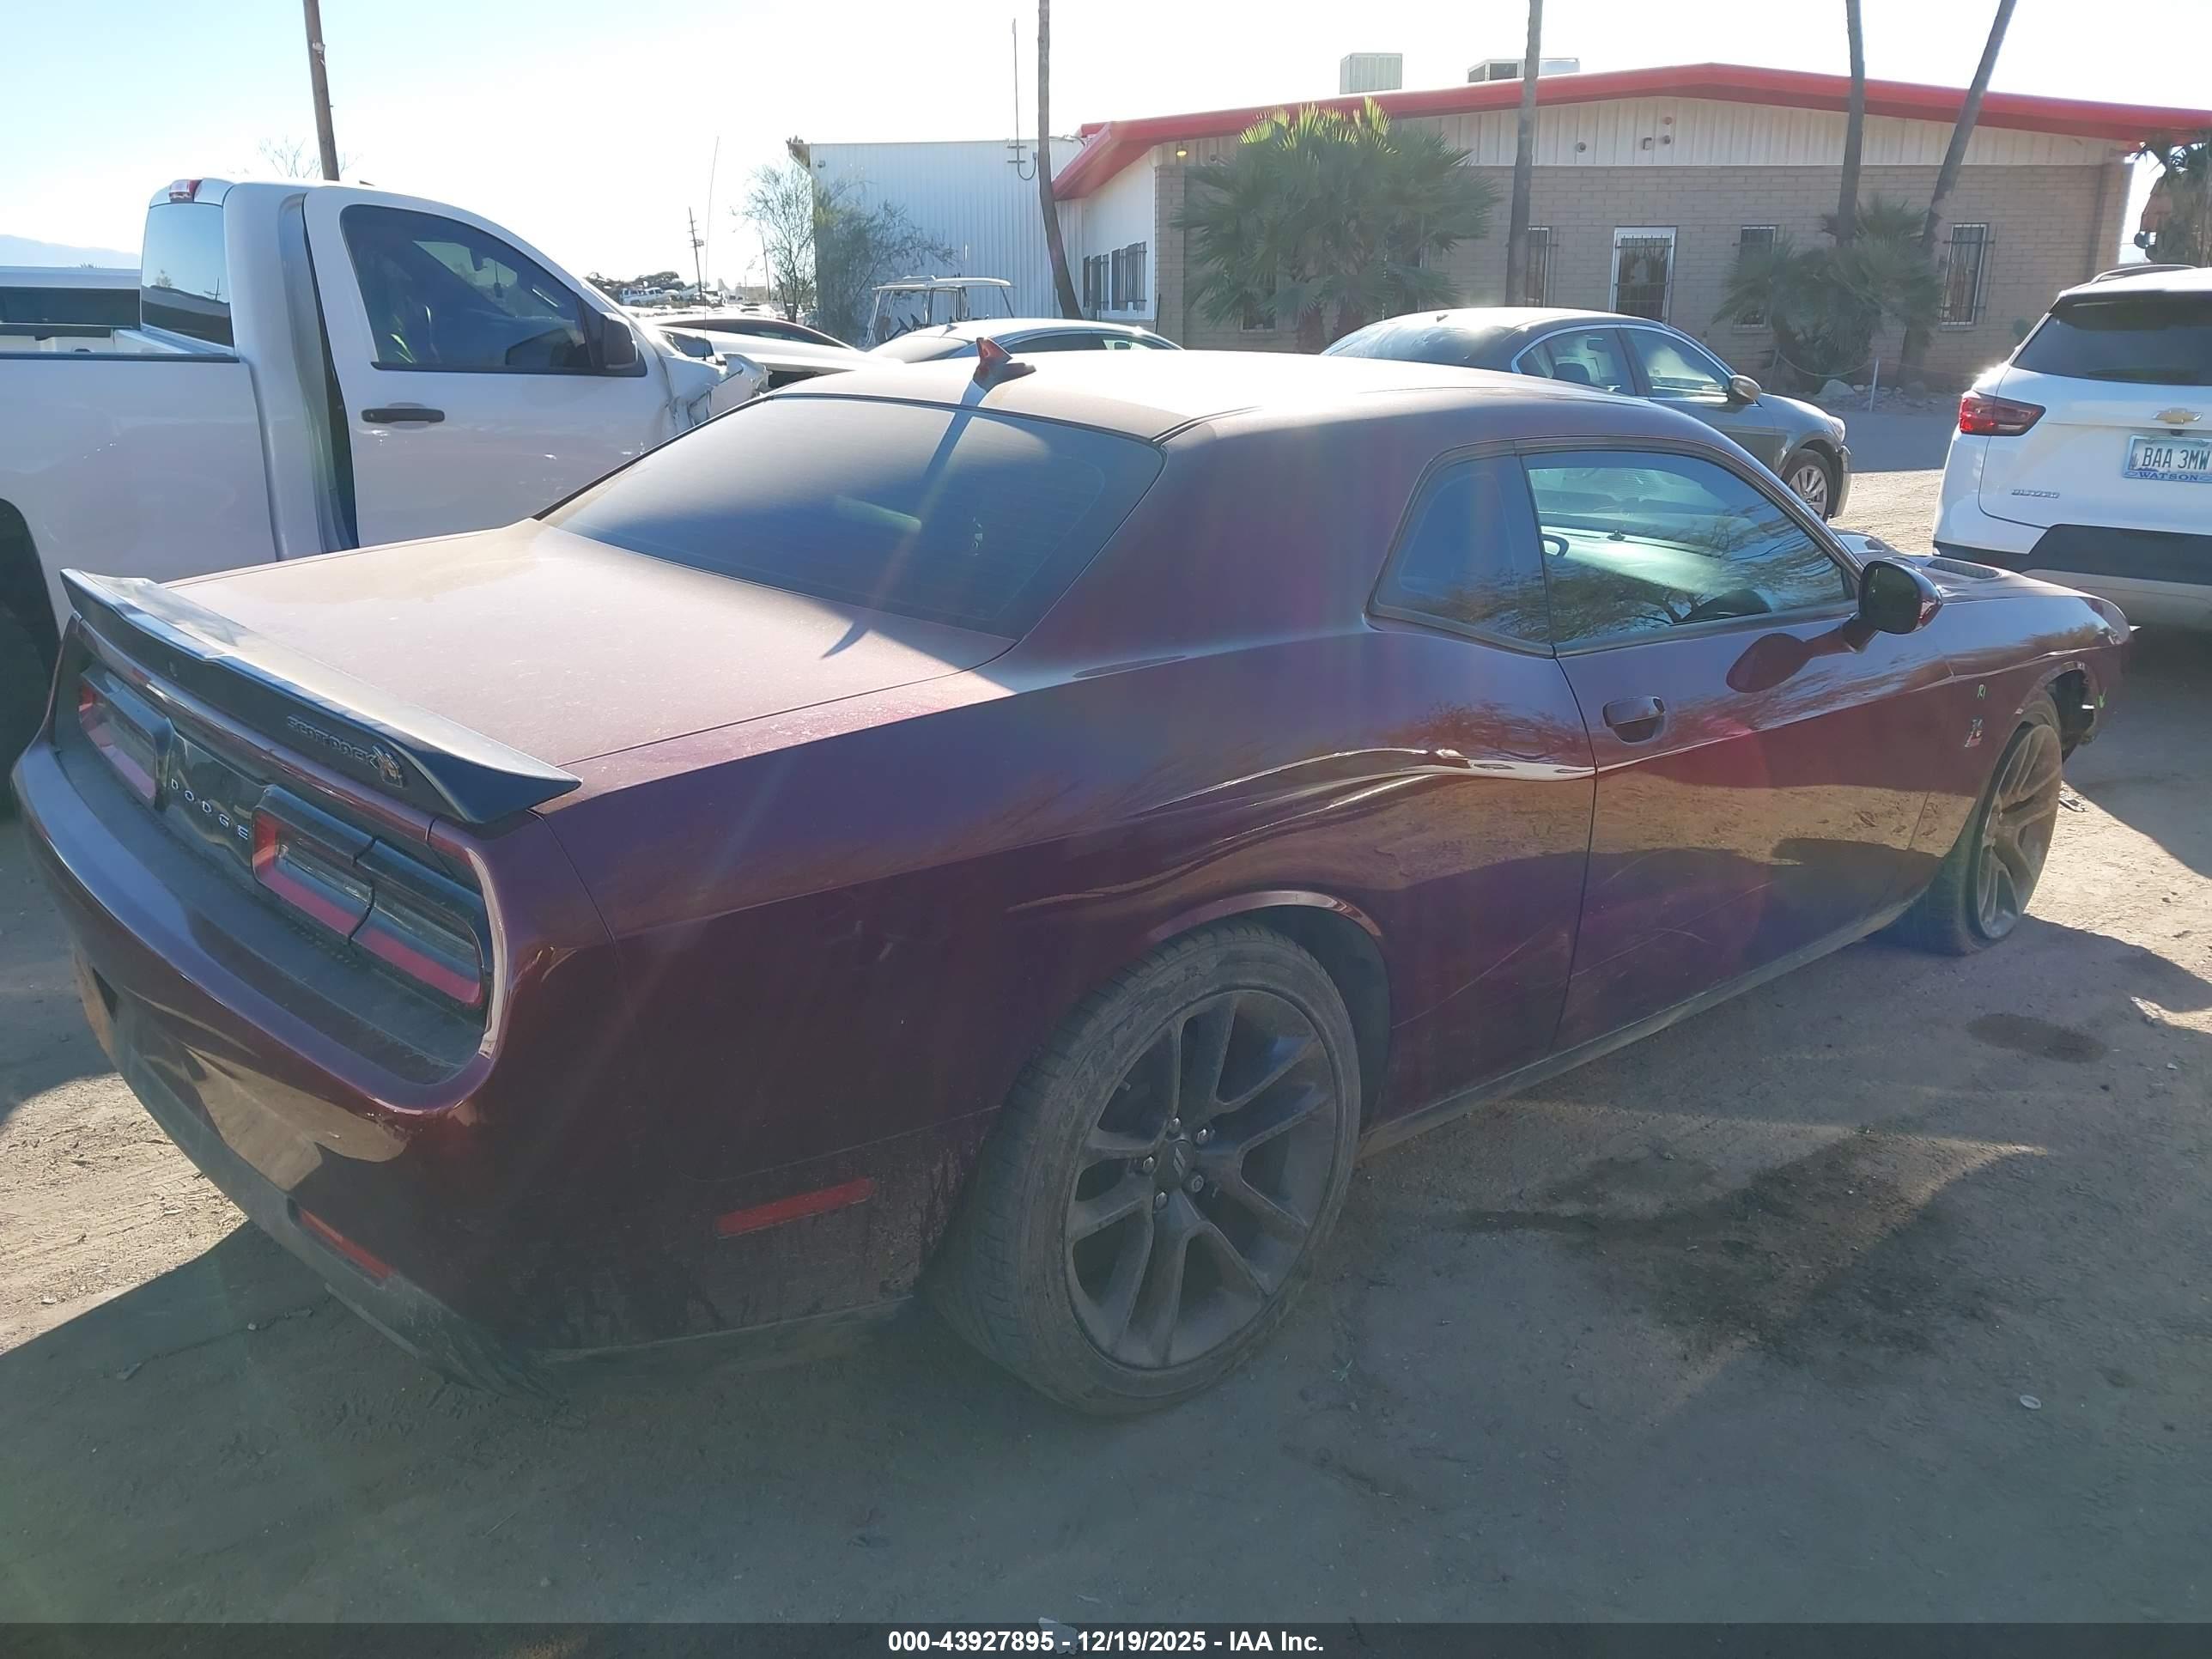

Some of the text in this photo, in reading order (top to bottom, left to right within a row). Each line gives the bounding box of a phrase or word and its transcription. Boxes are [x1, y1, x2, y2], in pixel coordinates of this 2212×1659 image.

[2142, 447, 2211, 471] BAA 3MW
[2139, 471, 2199, 481] WATSON
[171, 778, 248, 840] DODGE
